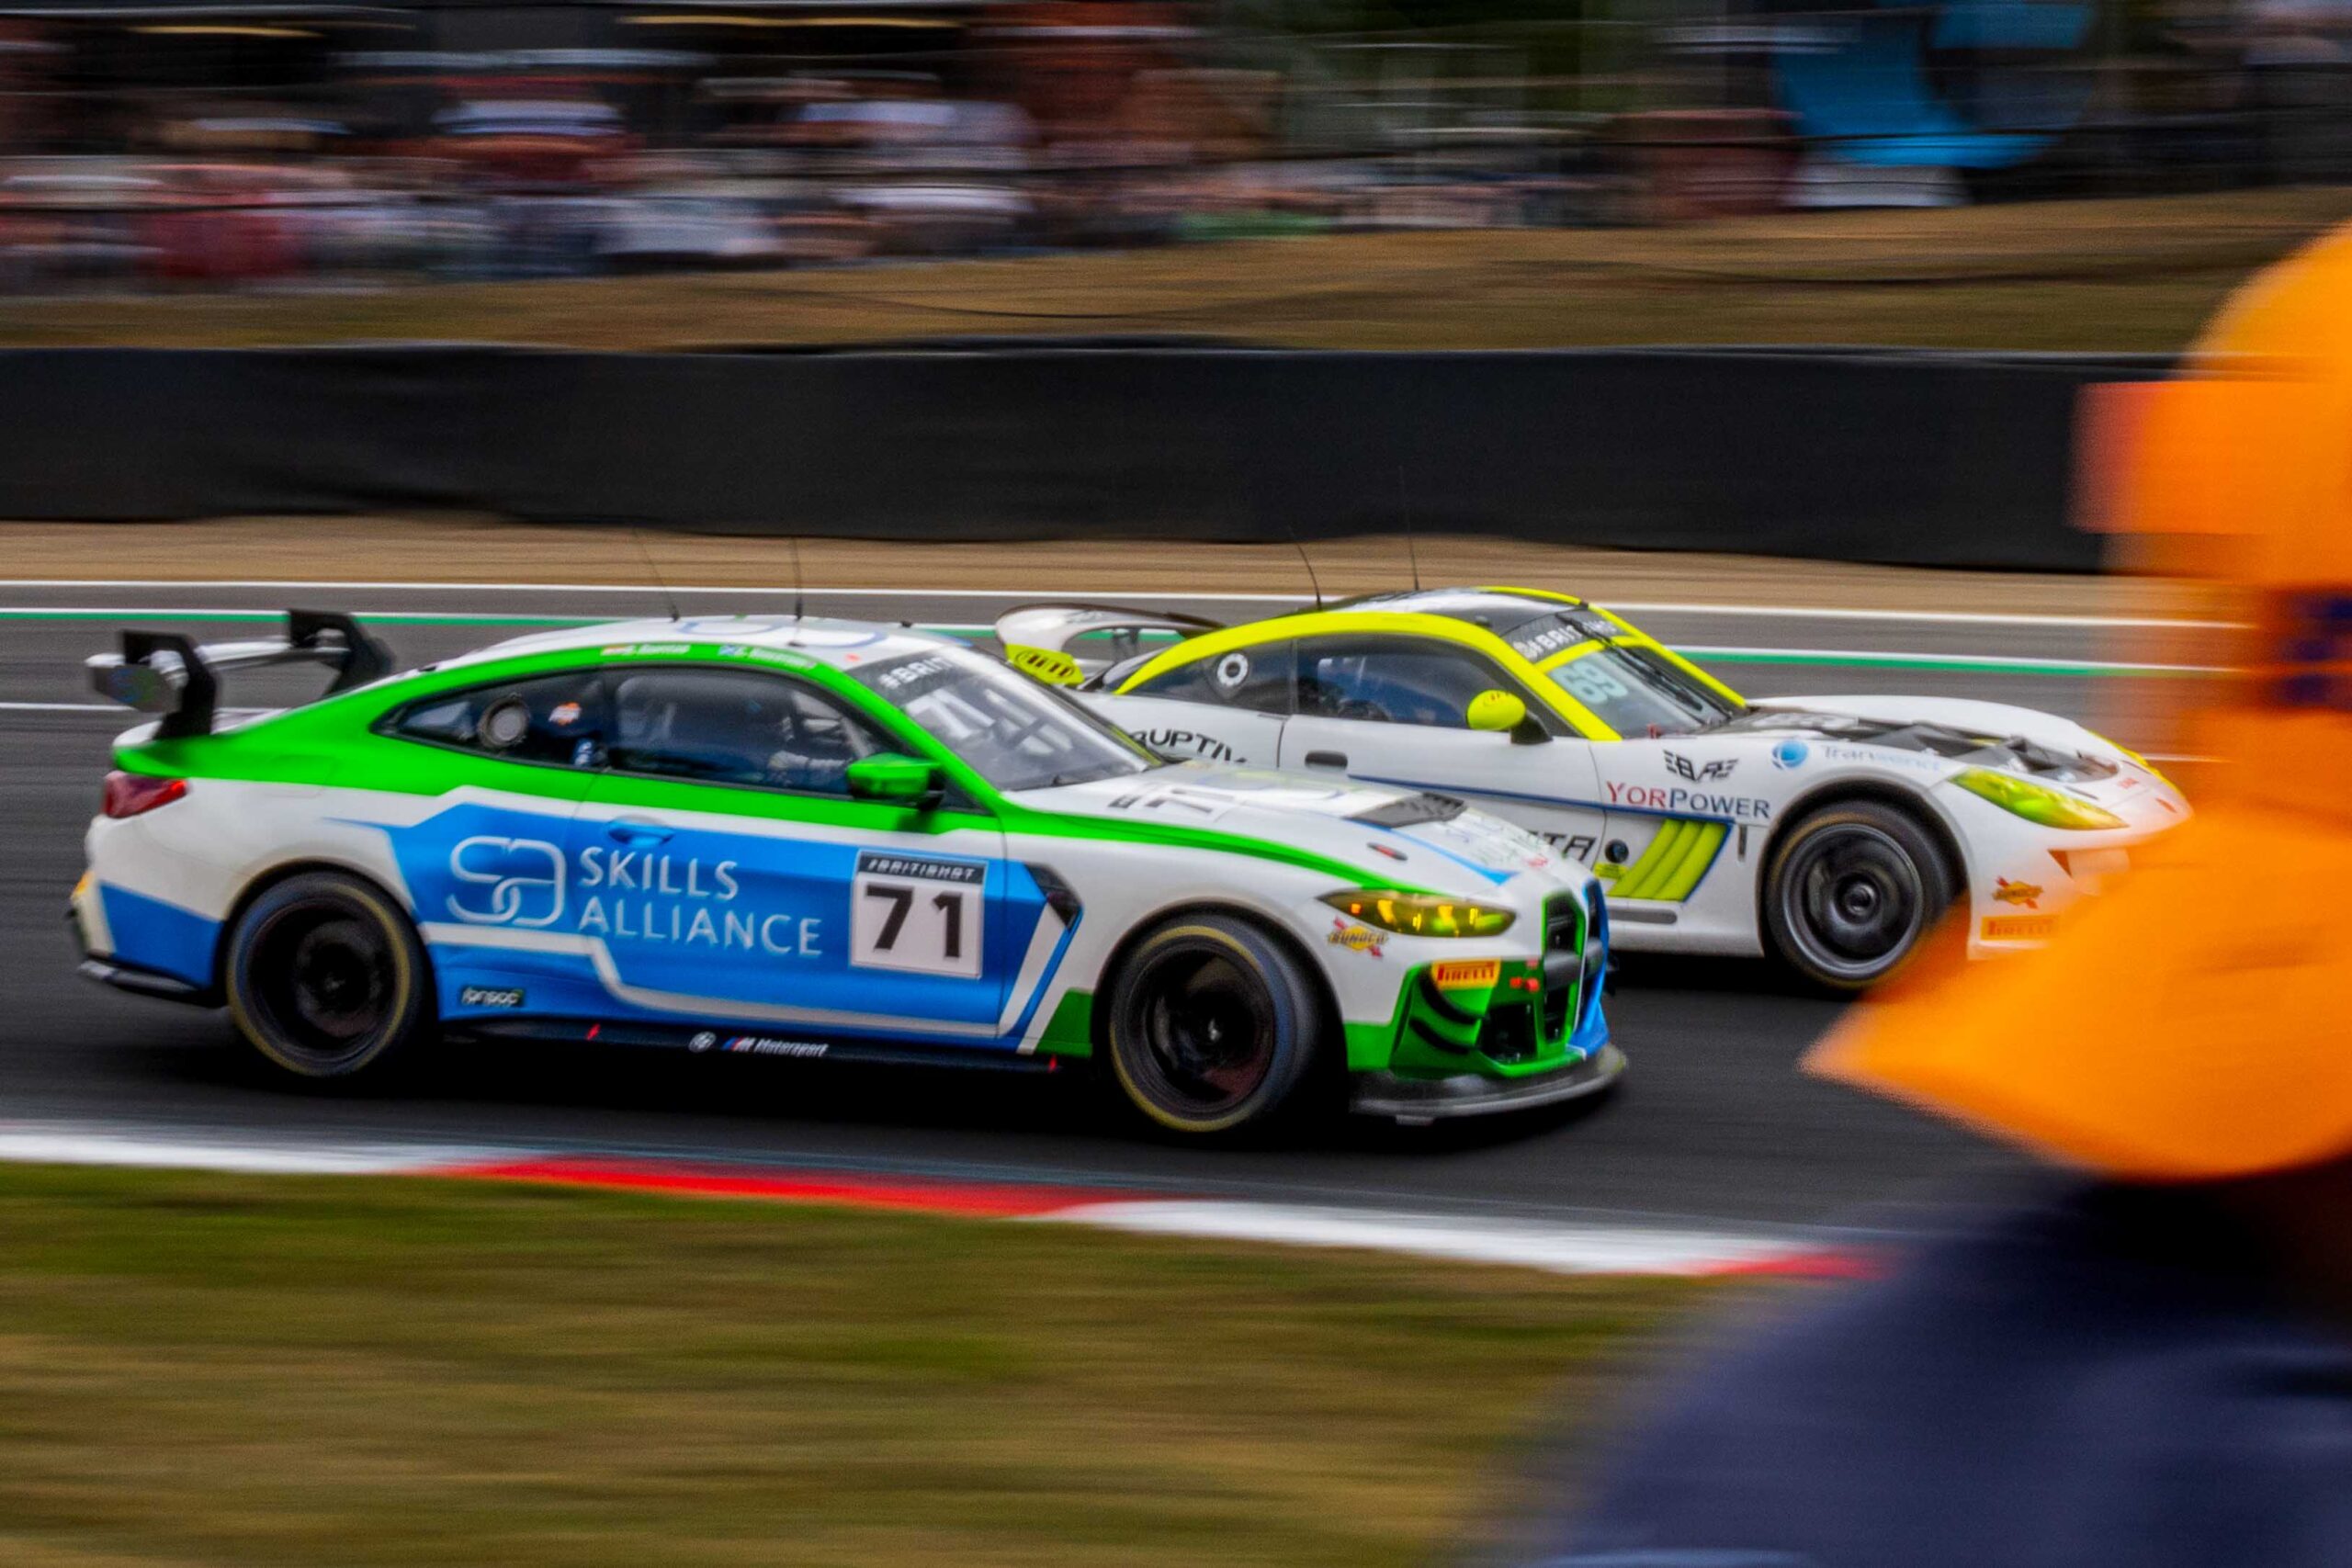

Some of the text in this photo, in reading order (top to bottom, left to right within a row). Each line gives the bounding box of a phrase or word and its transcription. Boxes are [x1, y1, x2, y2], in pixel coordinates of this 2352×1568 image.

[579, 846, 739, 901] SKILLS
[578, 897, 823, 957] ALLIANCE
[866, 884, 962, 958] 71
[754, 1039, 829, 1056] Motorsport
